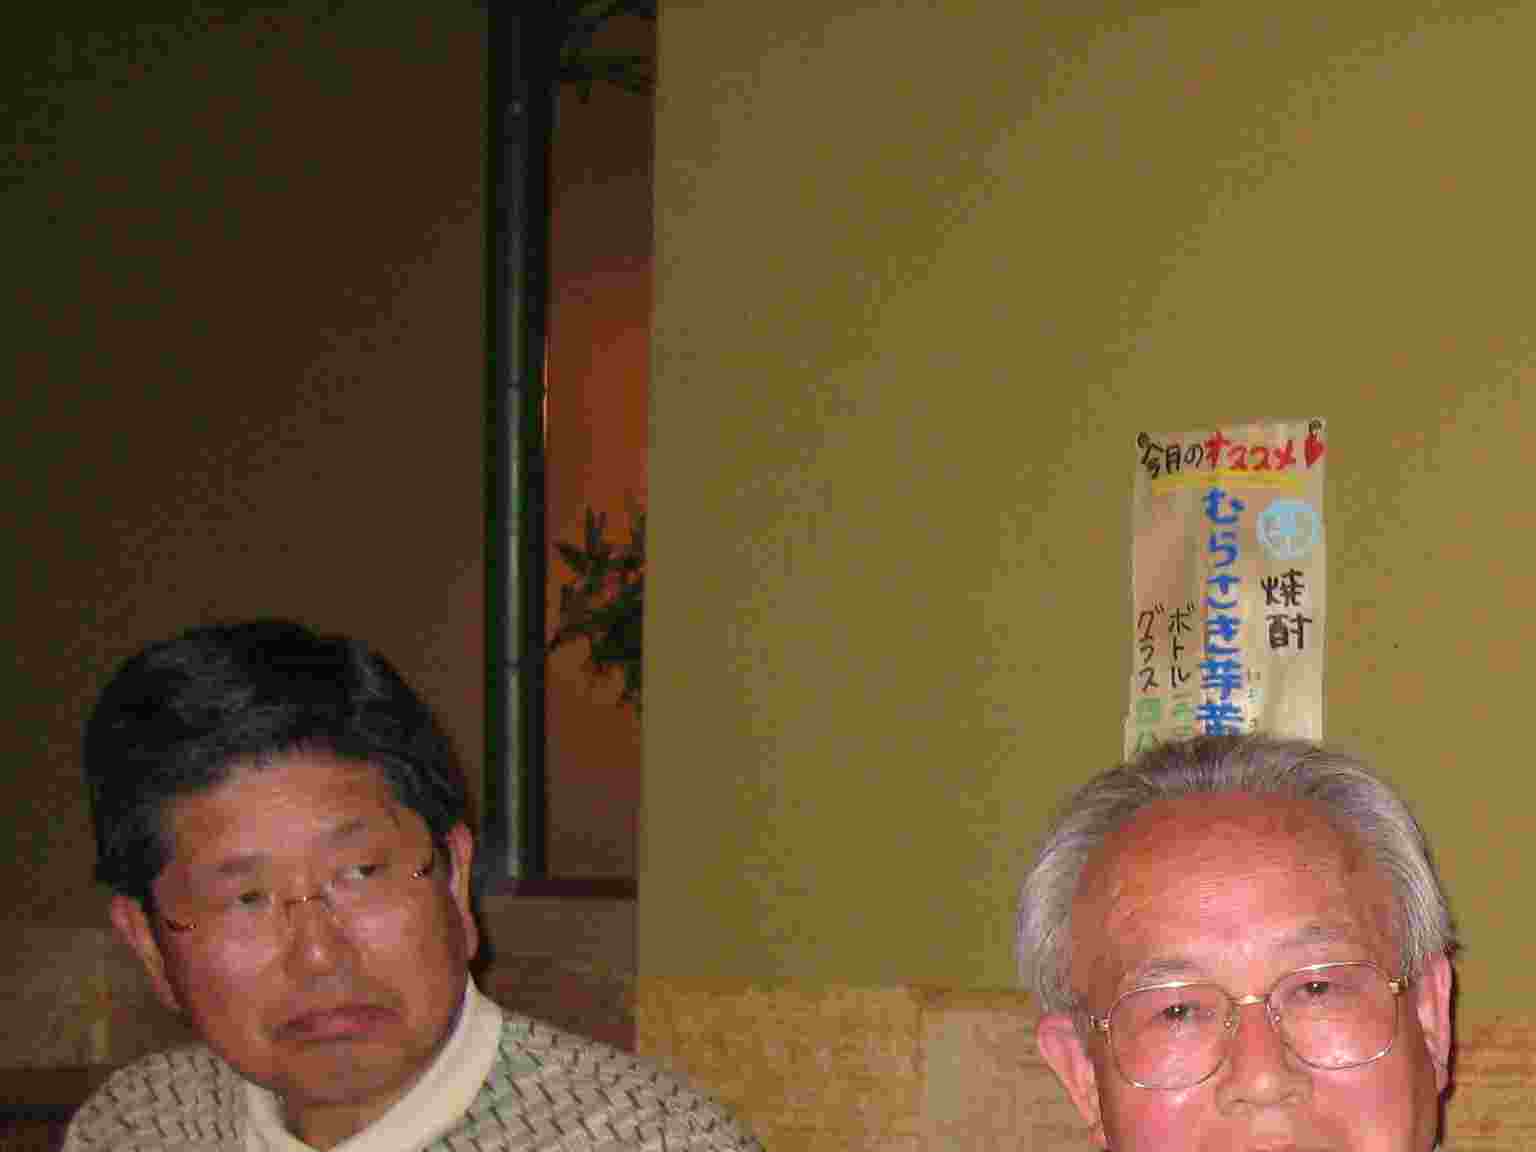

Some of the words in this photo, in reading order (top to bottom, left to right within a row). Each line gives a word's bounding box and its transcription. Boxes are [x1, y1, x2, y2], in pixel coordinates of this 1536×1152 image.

[1141, 429, 1297, 479] 今月のオススメ
[1137, 600, 1164, 692] グラス
[1168, 600, 1195, 688] ボトル
[1261, 569, 1313, 650] 焼酎
